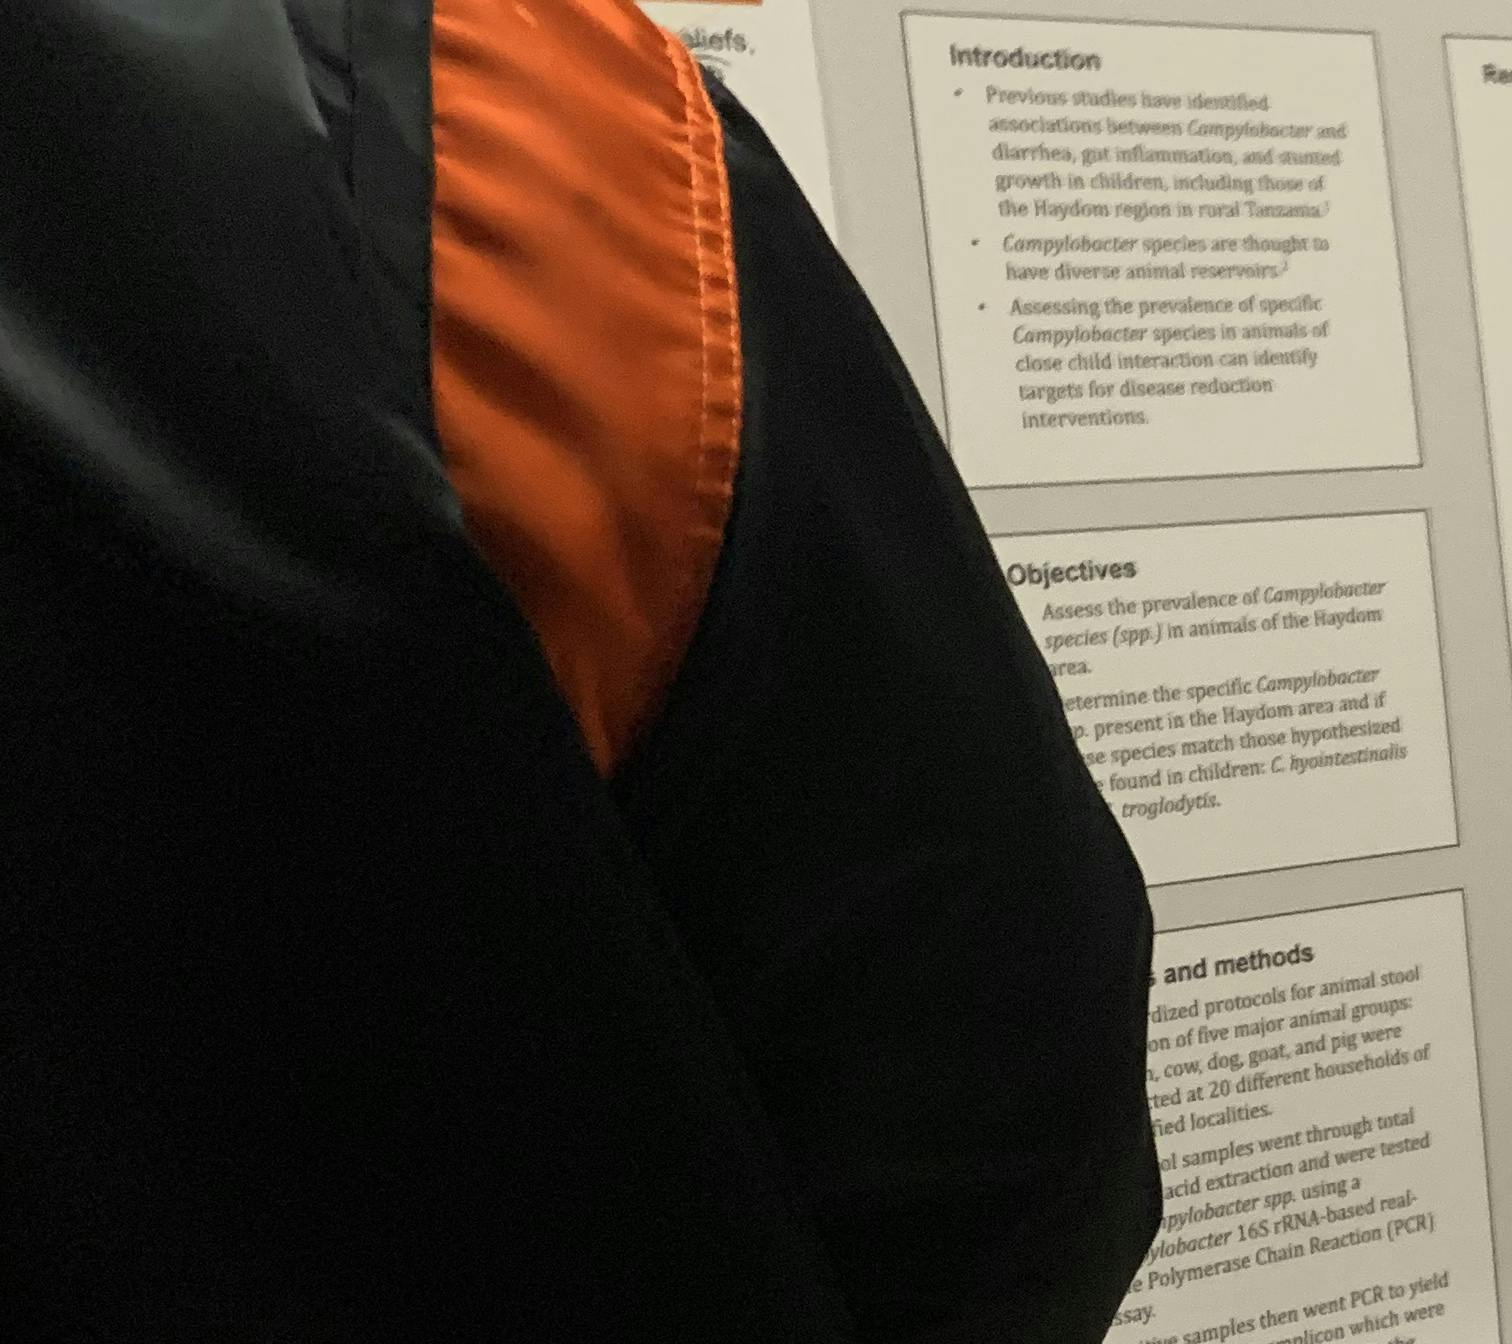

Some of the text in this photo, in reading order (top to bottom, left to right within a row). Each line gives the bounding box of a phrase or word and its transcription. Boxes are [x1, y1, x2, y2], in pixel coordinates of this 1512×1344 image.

[949, 44, 1101, 71] Introduction
[985, 84, 1069, 106] Previous
[1071, 89, 1138, 108] studies
[1140, 91, 1182, 110] have
[1009, 294, 1322, 320] Assessing the prevalence of specific
[1012, 320, 1329, 348] Campylobacter species in animals of
[1015, 347, 1318, 373] close child interaction can identify
[1018, 376, 1274, 405] targets for disease reduction
[1007, 560, 1137, 591] Objectives
[1042, 581, 1387, 621] Assess the prevalence of Campylobacter
[1044, 607, 1383, 654] species (spp.) in animals of the Haydom
[1064, 669, 1380, 714] etermine the specific Campylobacter
[1093, 690, 1386, 742] present in the Haydom area and if
[1110, 716, 1402, 767] species match those hypothesized
[1109, 768, 1162, 792] found
[1167, 769, 1184, 786] in
[1121, 791, 1221, 821] troglodytis.
[1164, 943, 1315, 984] and methods
[1150, 964, 1420, 1024] dized protocols for animal stool
[1186, 1043, 1431, 1103] at 20 different households of
[1182, 1106, 1415, 1168] samples went through total
[1163, 1131, 1431, 1200] acid extraction and were tested
[1263, 1190, 1296, 1212] spp.
[1301, 1179, 1348, 1200] using
[1351, 1177, 1361, 1190] a
[1237, 1219, 1270, 1242] 16S
[1273, 1196, 1376, 1235] rRNA-based
[1148, 1212, 1434, 1290] Polymerase Chain Reaction (PCR)
[1259, 1309, 1299, 1330] then
[1302, 1296, 1347, 1318] went
[1350, 1284, 1384, 1309] PCR
[1388, 1285, 1405, 1300] to
[1408, 1270, 1449, 1300] yield
[1348, 1310, 1400, 1336] which
[1403, 1303, 1445, 1323] were
